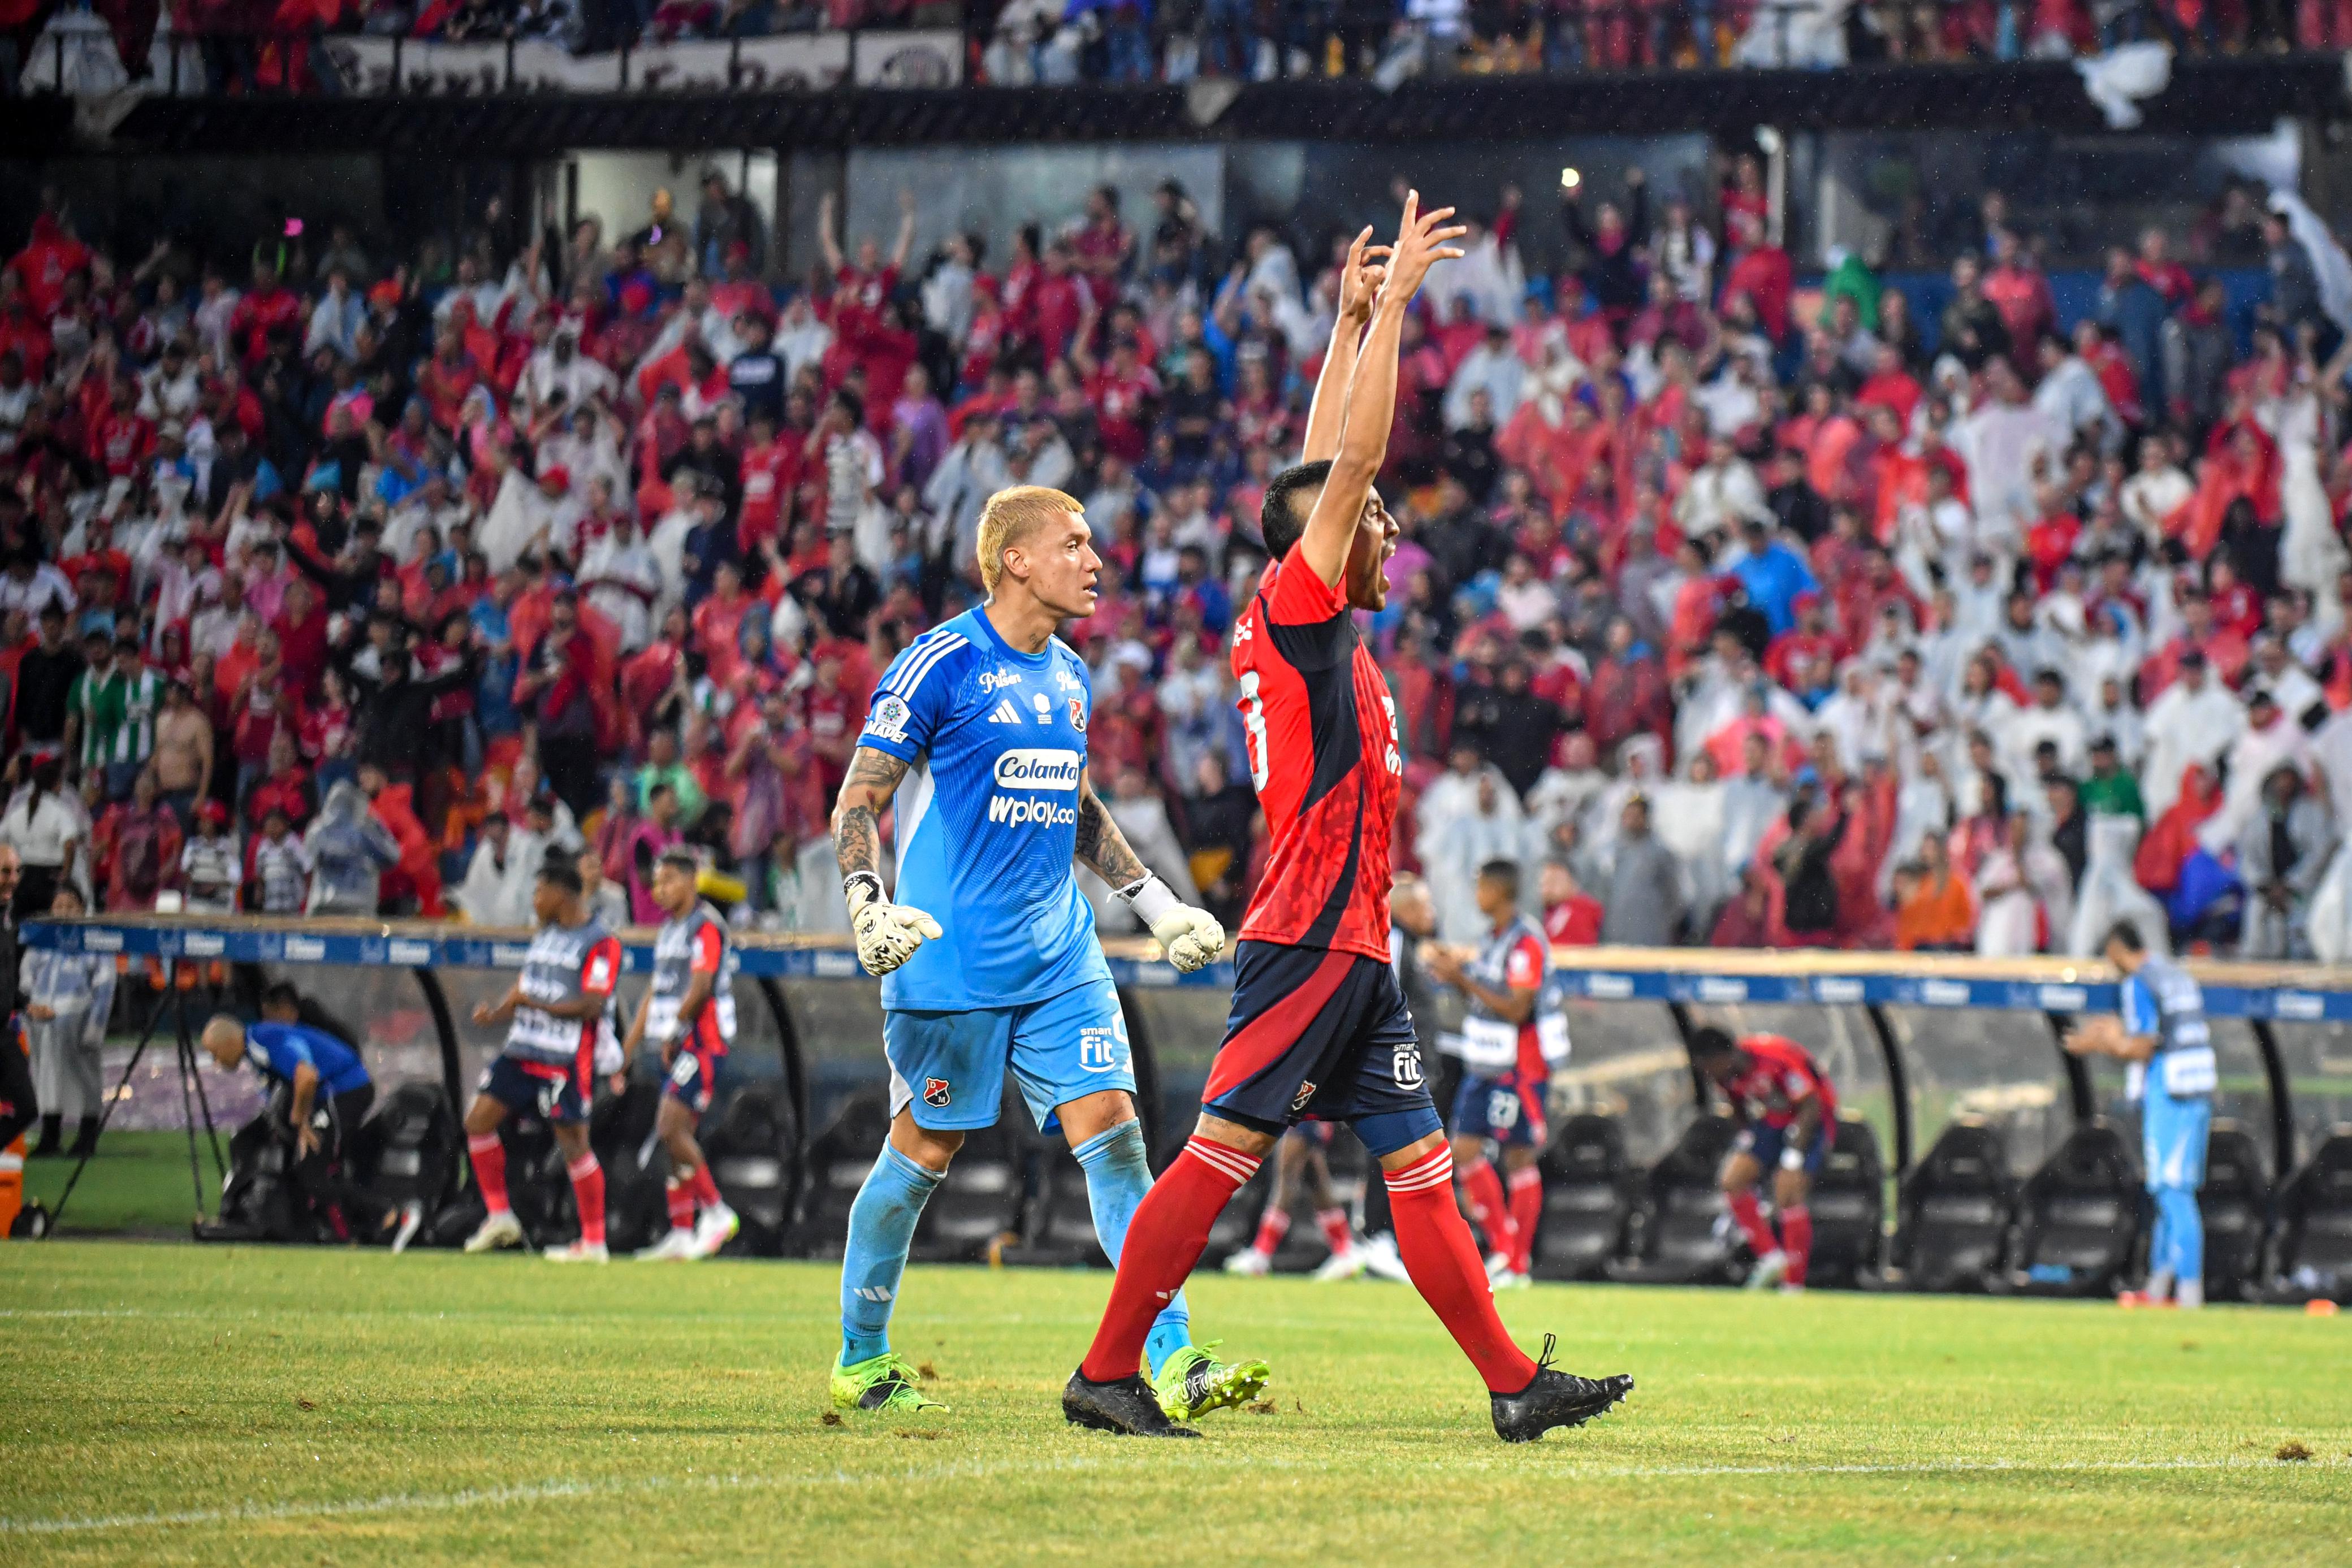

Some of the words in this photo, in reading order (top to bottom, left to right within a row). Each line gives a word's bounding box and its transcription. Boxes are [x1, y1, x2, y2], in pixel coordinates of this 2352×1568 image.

[979, 670, 1022, 694] Pilsen
[863, 720, 909, 744] MAPEI
[879, 719, 897, 727] DIMAYOR
[998, 756, 1078, 781] Colanta
[989, 795, 1075, 829] Wplay.co
[1080, 1027, 1112, 1036] smart
[1080, 1036, 1114, 1064] fit
[1393, 1043, 1415, 1052] smar
[1393, 1051, 1421, 1082] fit
